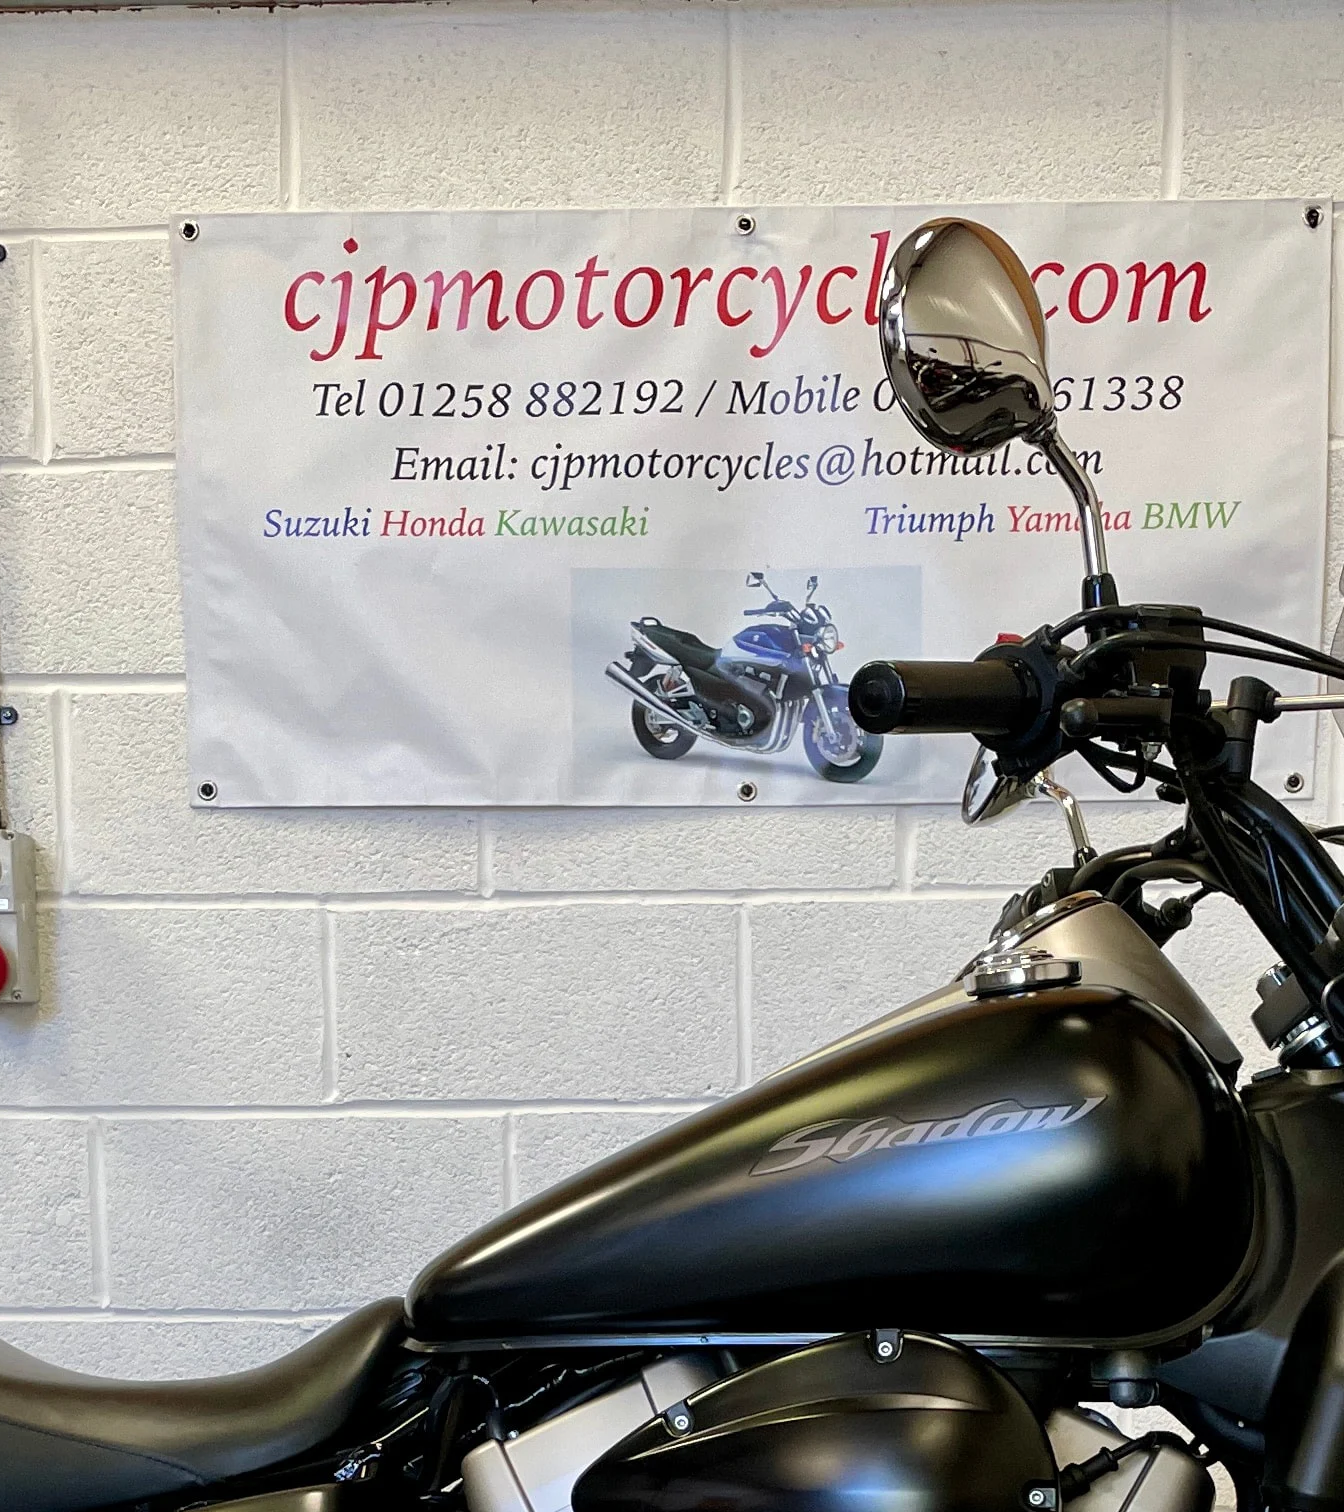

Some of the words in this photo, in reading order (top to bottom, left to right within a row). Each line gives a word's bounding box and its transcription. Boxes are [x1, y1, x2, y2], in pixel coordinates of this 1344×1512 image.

[283, 229, 1213, 363] cjpmotorcyclcom
[312, 379, 367, 416] Tel
[378, 381, 512, 419] 01258
[526, 378, 684, 418] 882192
[695, 380, 717, 417] /
[725, 373, 861, 416] Mobile
[1051, 374, 1185, 413] 61338
[390, 442, 518, 481] Email:
[263, 506, 371, 538] Suzuki
[380, 507, 485, 538] Honda
[495, 505, 649, 537] Kawasaki
[865, 503, 995, 542] Triumph
[1141, 500, 1241, 530] BMW
[749, 1094, 1108, 1176] Shadow
